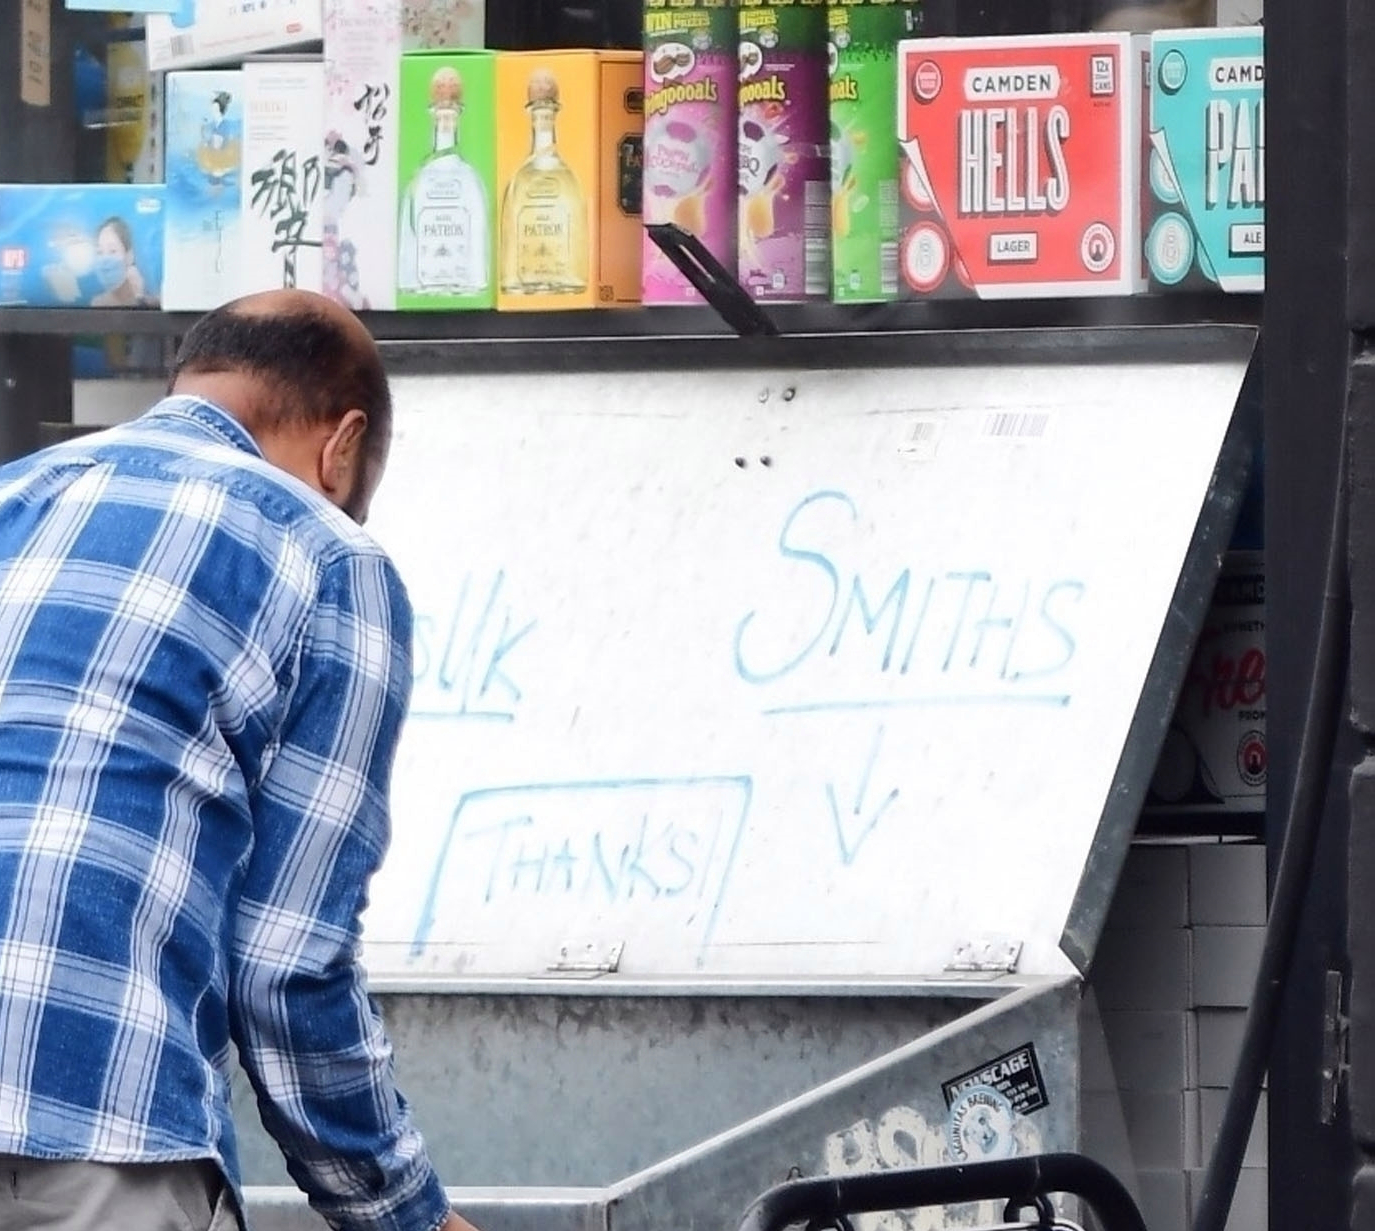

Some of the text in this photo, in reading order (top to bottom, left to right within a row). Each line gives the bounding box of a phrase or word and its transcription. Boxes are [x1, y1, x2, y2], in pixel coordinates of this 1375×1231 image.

[972, 74, 1052, 93] CAMDEN
[958, 105, 1071, 218] HELLS
[996, 239, 1031, 254] LAGER
[733, 488, 1087, 685] SMITHS
